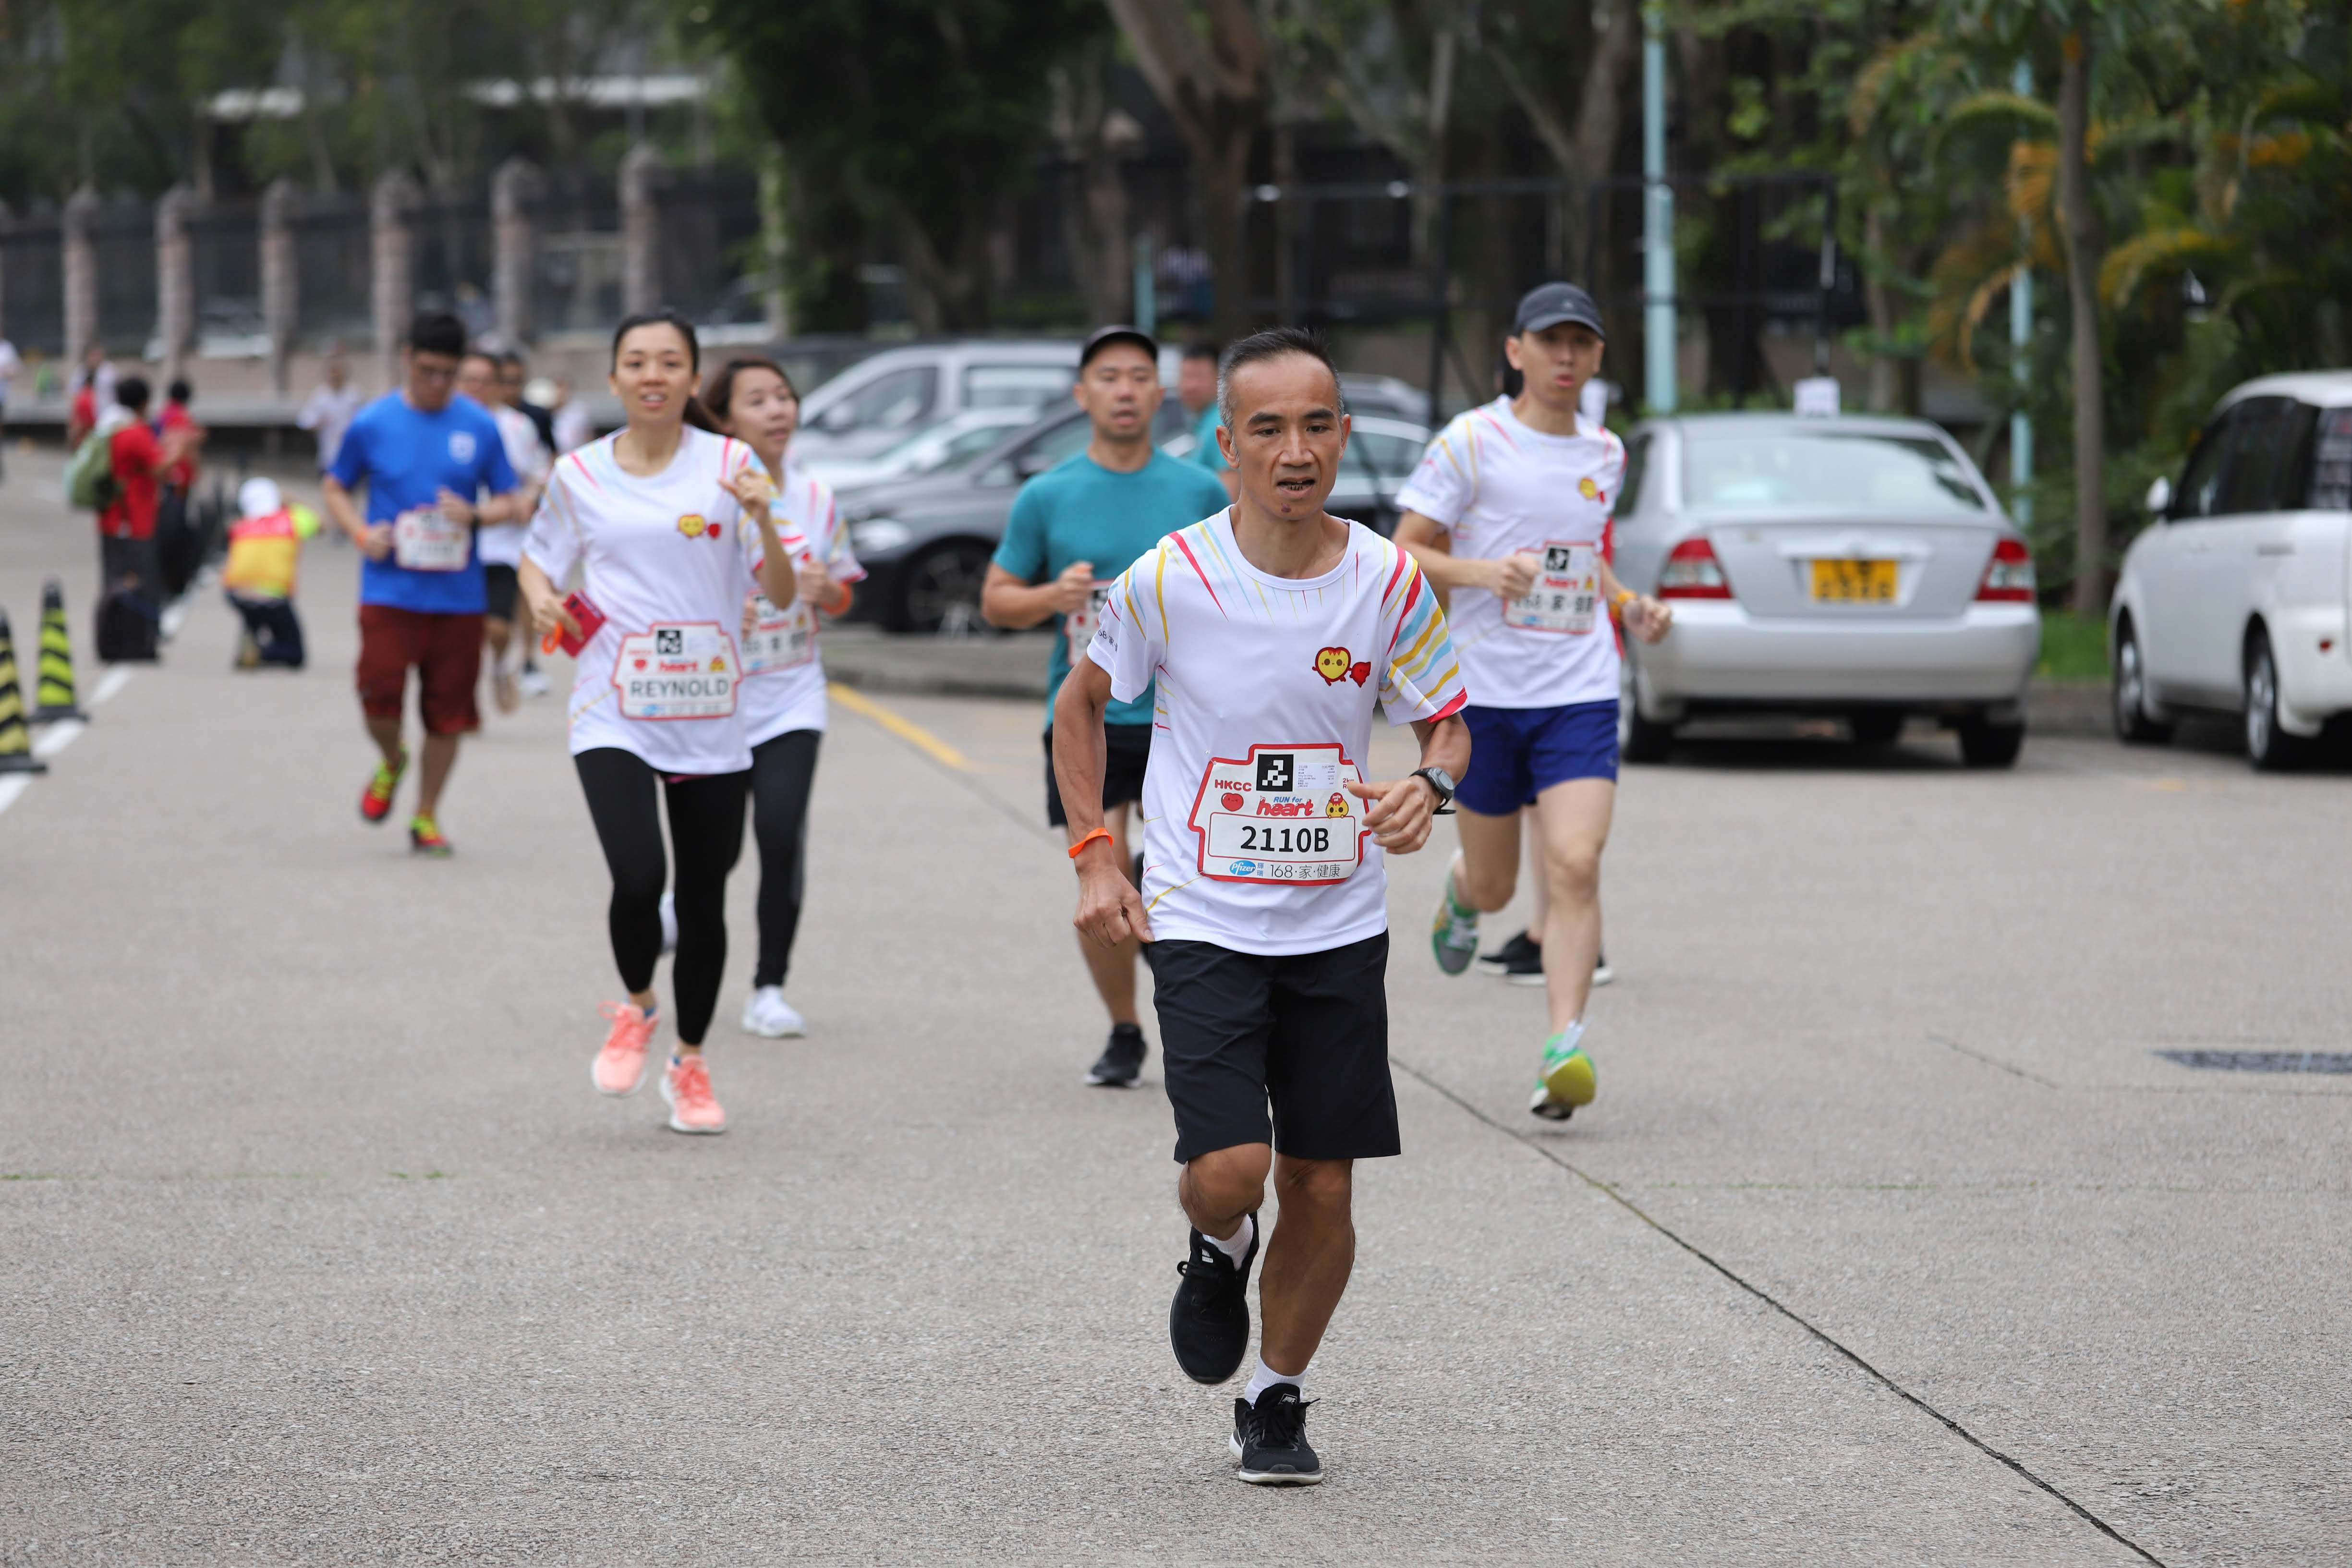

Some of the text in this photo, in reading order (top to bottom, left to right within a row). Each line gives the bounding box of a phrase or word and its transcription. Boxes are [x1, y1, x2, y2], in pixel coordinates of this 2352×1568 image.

[630, 679, 728, 697] REYNOLD
[1214, 779, 1252, 792] HKCC
[1256, 796, 1314, 816] heart
[1241, 826, 1329, 852] 2110B
[1231, 861, 1256, 875] Pfizer
